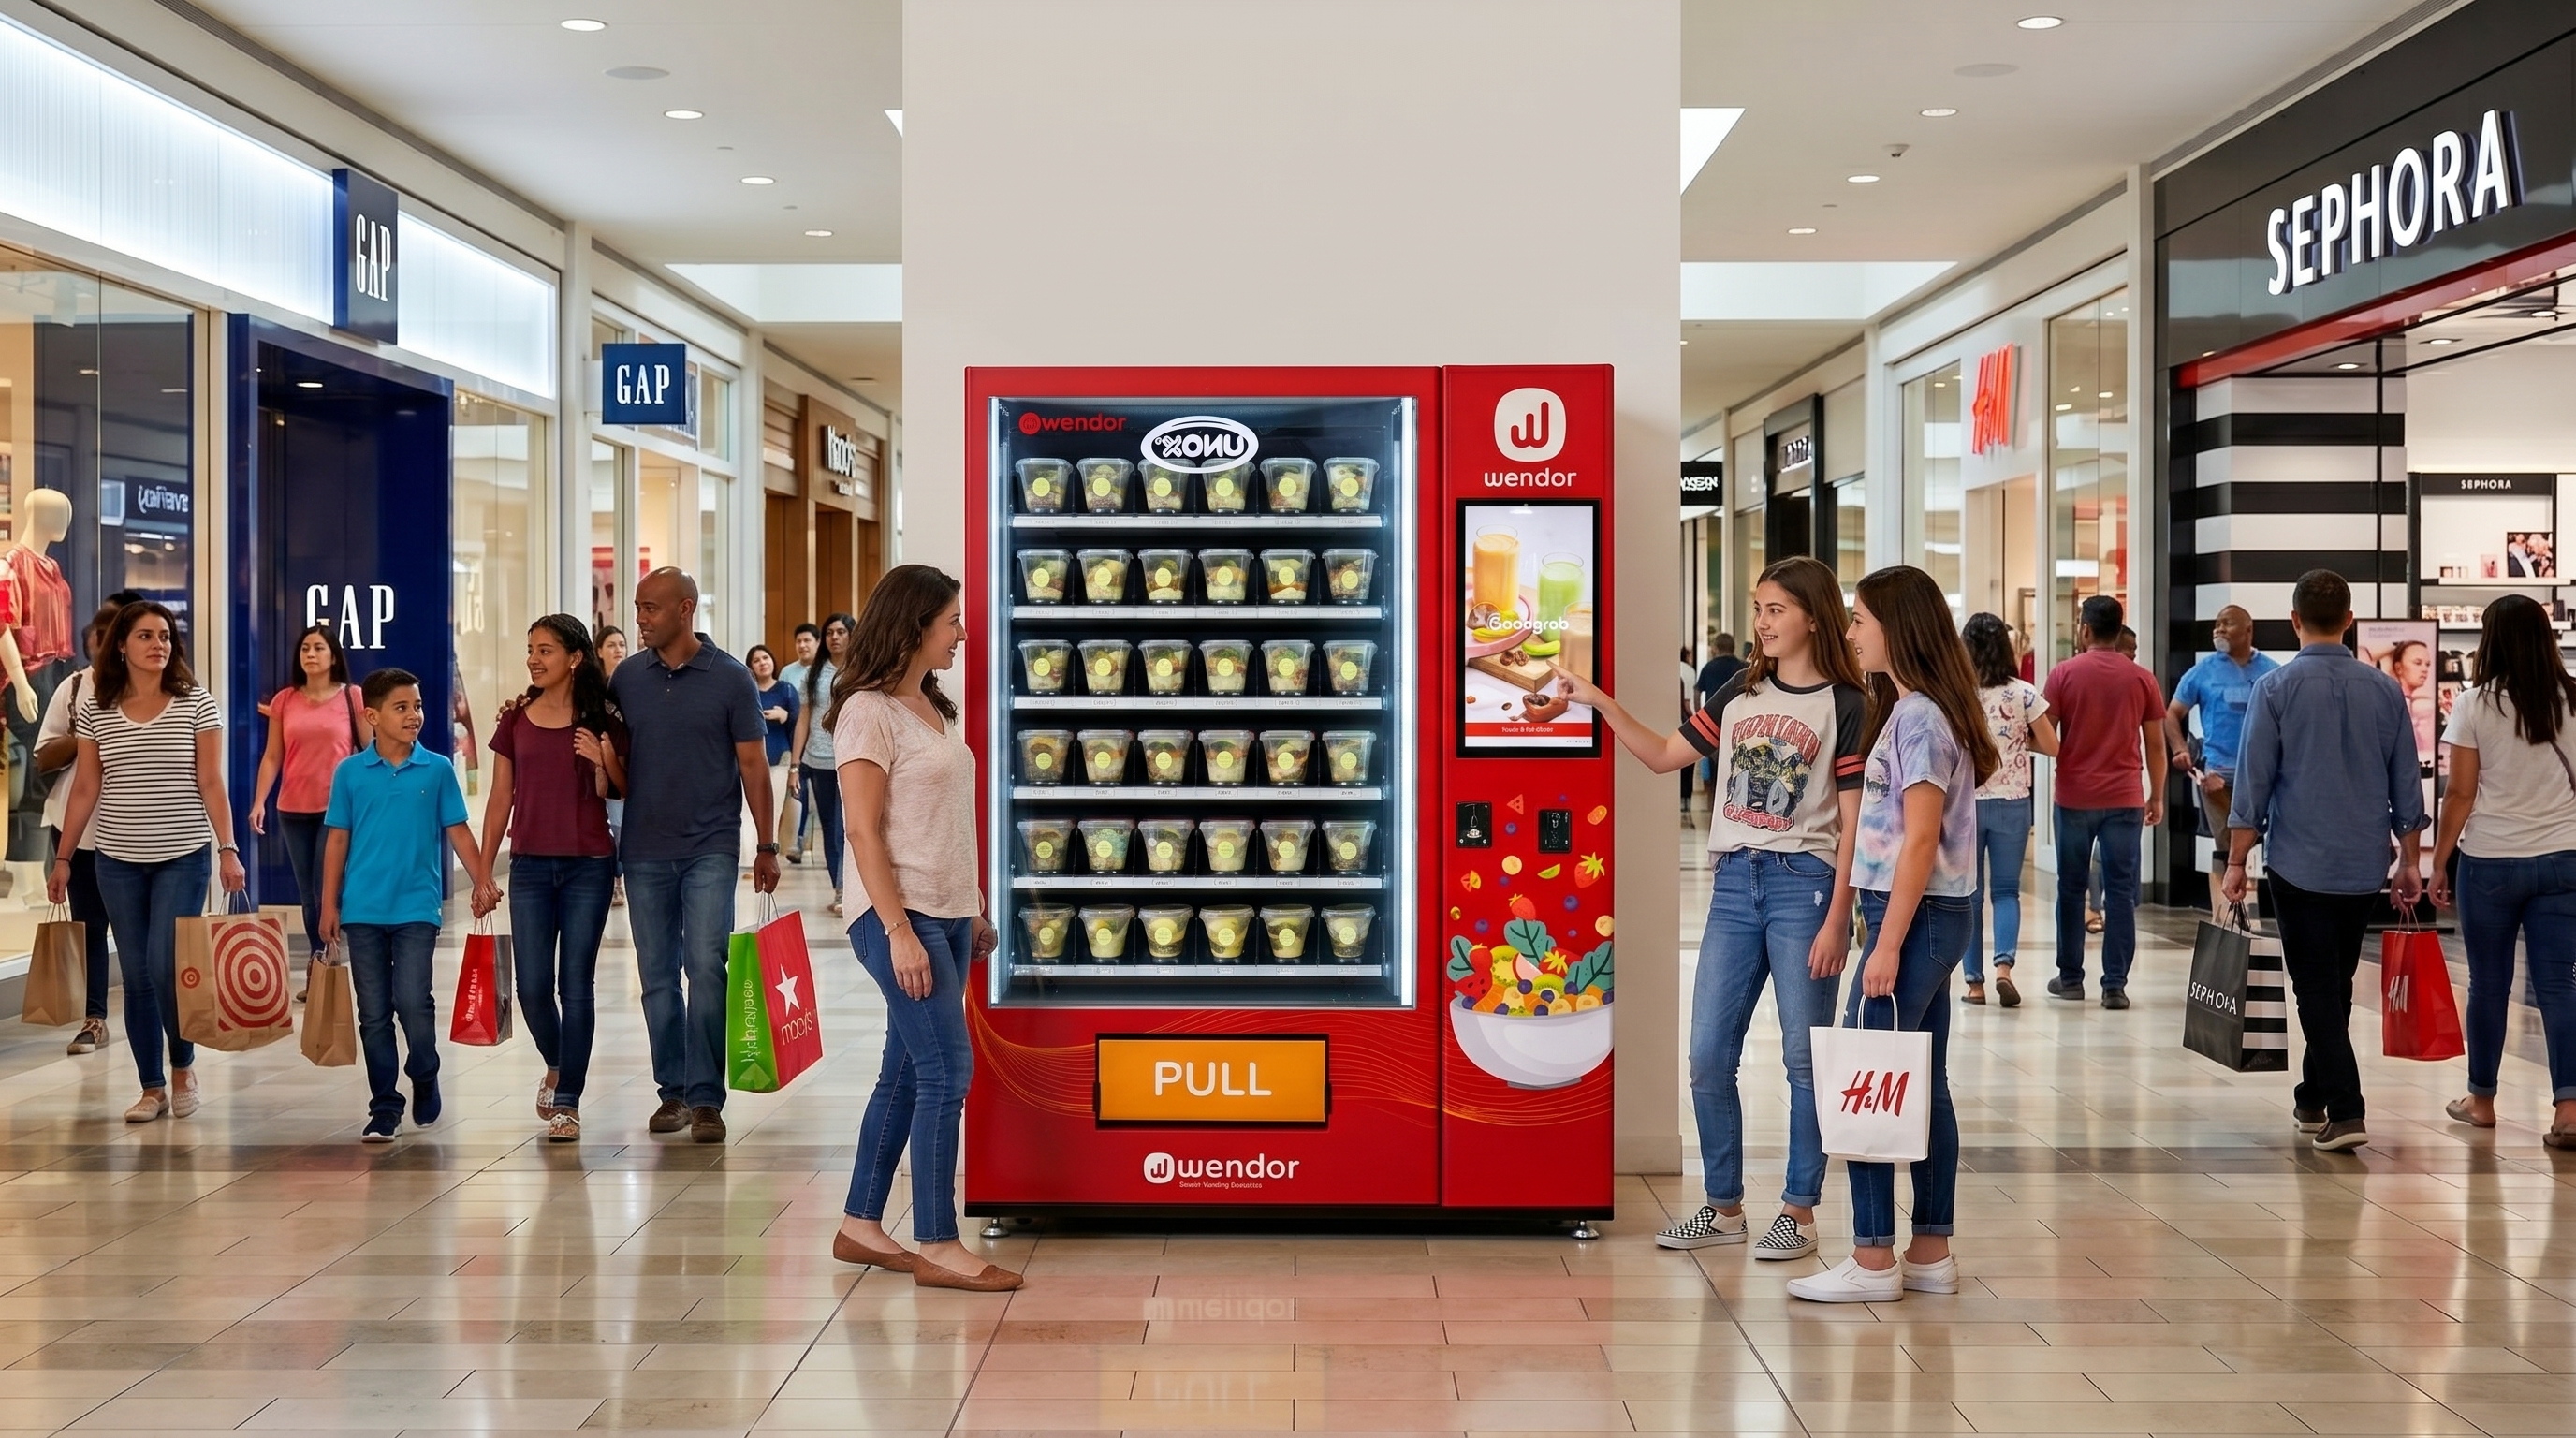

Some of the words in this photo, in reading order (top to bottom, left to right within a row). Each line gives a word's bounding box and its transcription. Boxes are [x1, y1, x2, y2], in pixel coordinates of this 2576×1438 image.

[2267, 109, 2510, 296] SEPHORA
[356, 213, 391, 302] GAP
[616, 364, 670, 404] GAP
[1042, 413, 1127, 432] wendor
[1484, 467, 1577, 488] wendor
[306, 584, 395, 650] GAP
[1155, 1061, 1272, 1097] PULL
[1840, 1070, 1910, 1117] H&M
[1178, 1152, 1300, 1180] wendor
